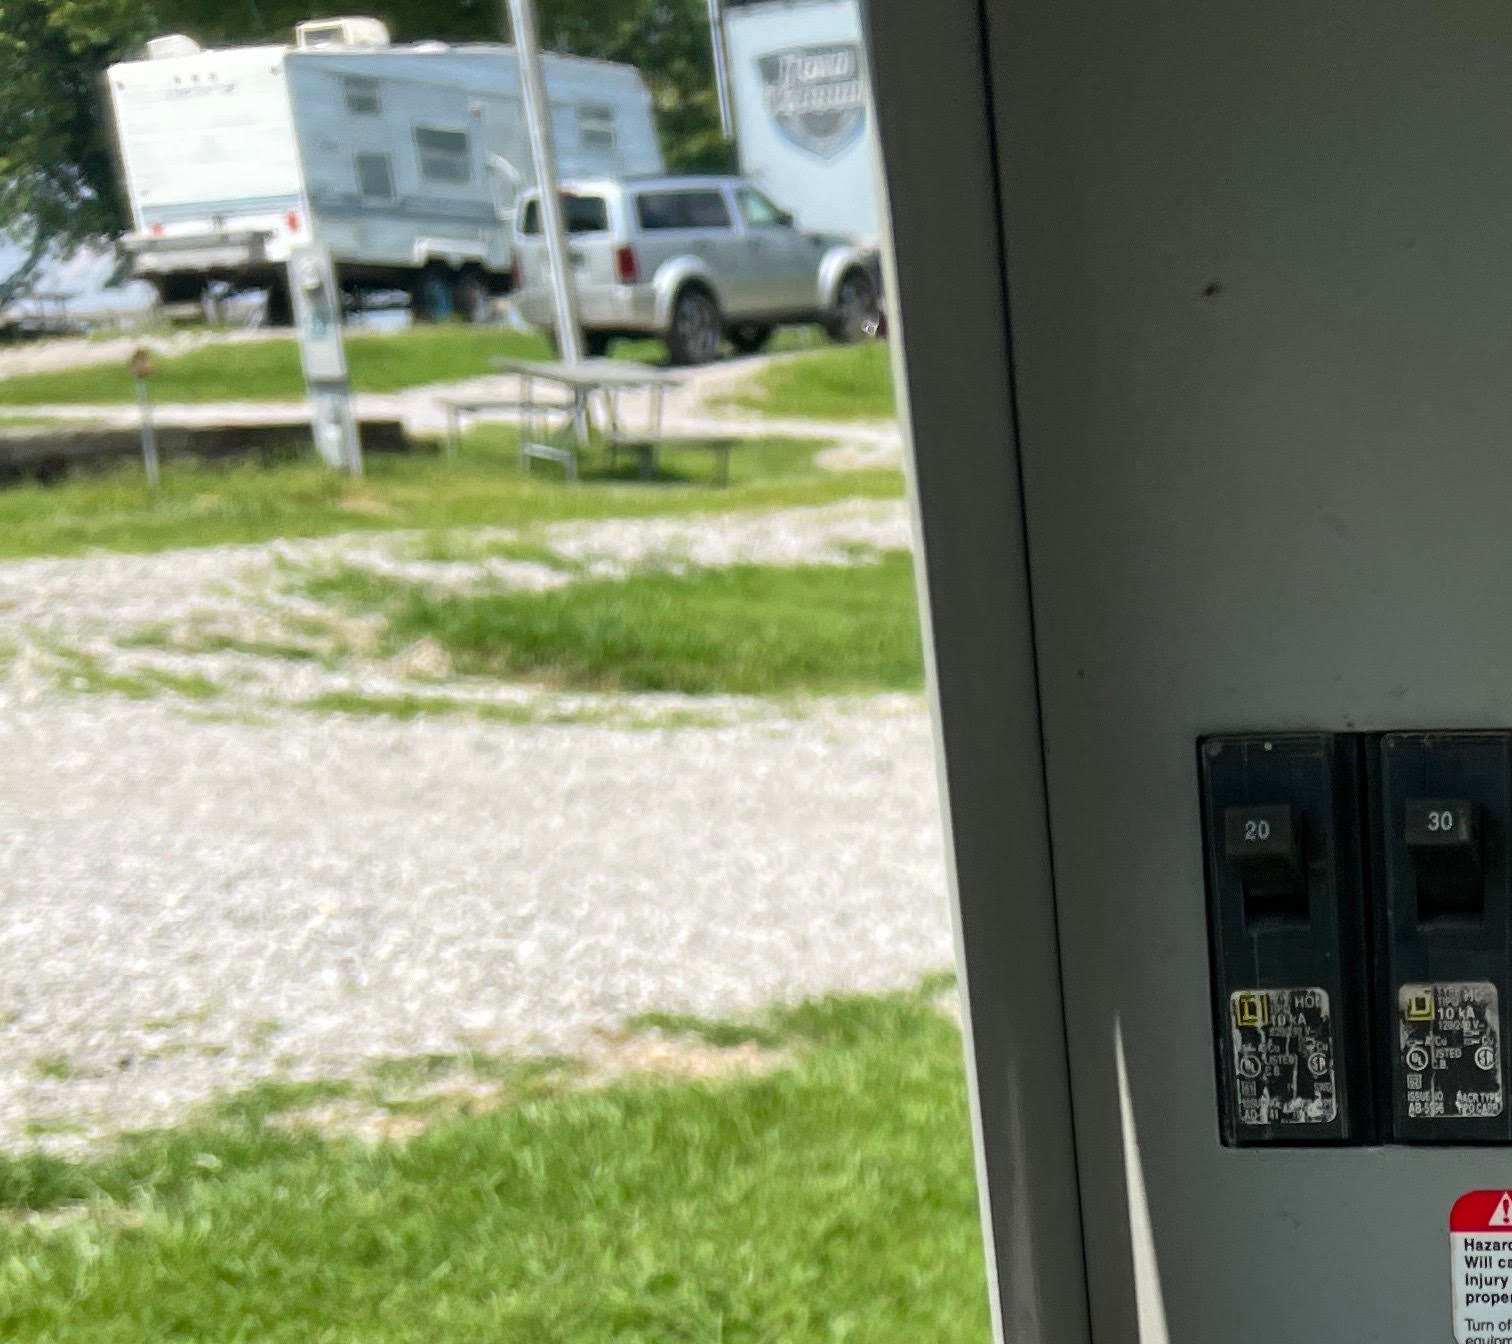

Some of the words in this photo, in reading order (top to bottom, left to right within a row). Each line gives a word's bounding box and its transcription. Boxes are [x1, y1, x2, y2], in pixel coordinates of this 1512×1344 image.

[1427, 811, 1454, 832] 30
[1244, 821, 1272, 841] 20
[1438, 1007, 1455, 1020] 10
[1464, 1256, 1493, 1269] Will
[1464, 1273, 1508, 1289] injury
[1464, 1318, 1494, 1332] Turn
